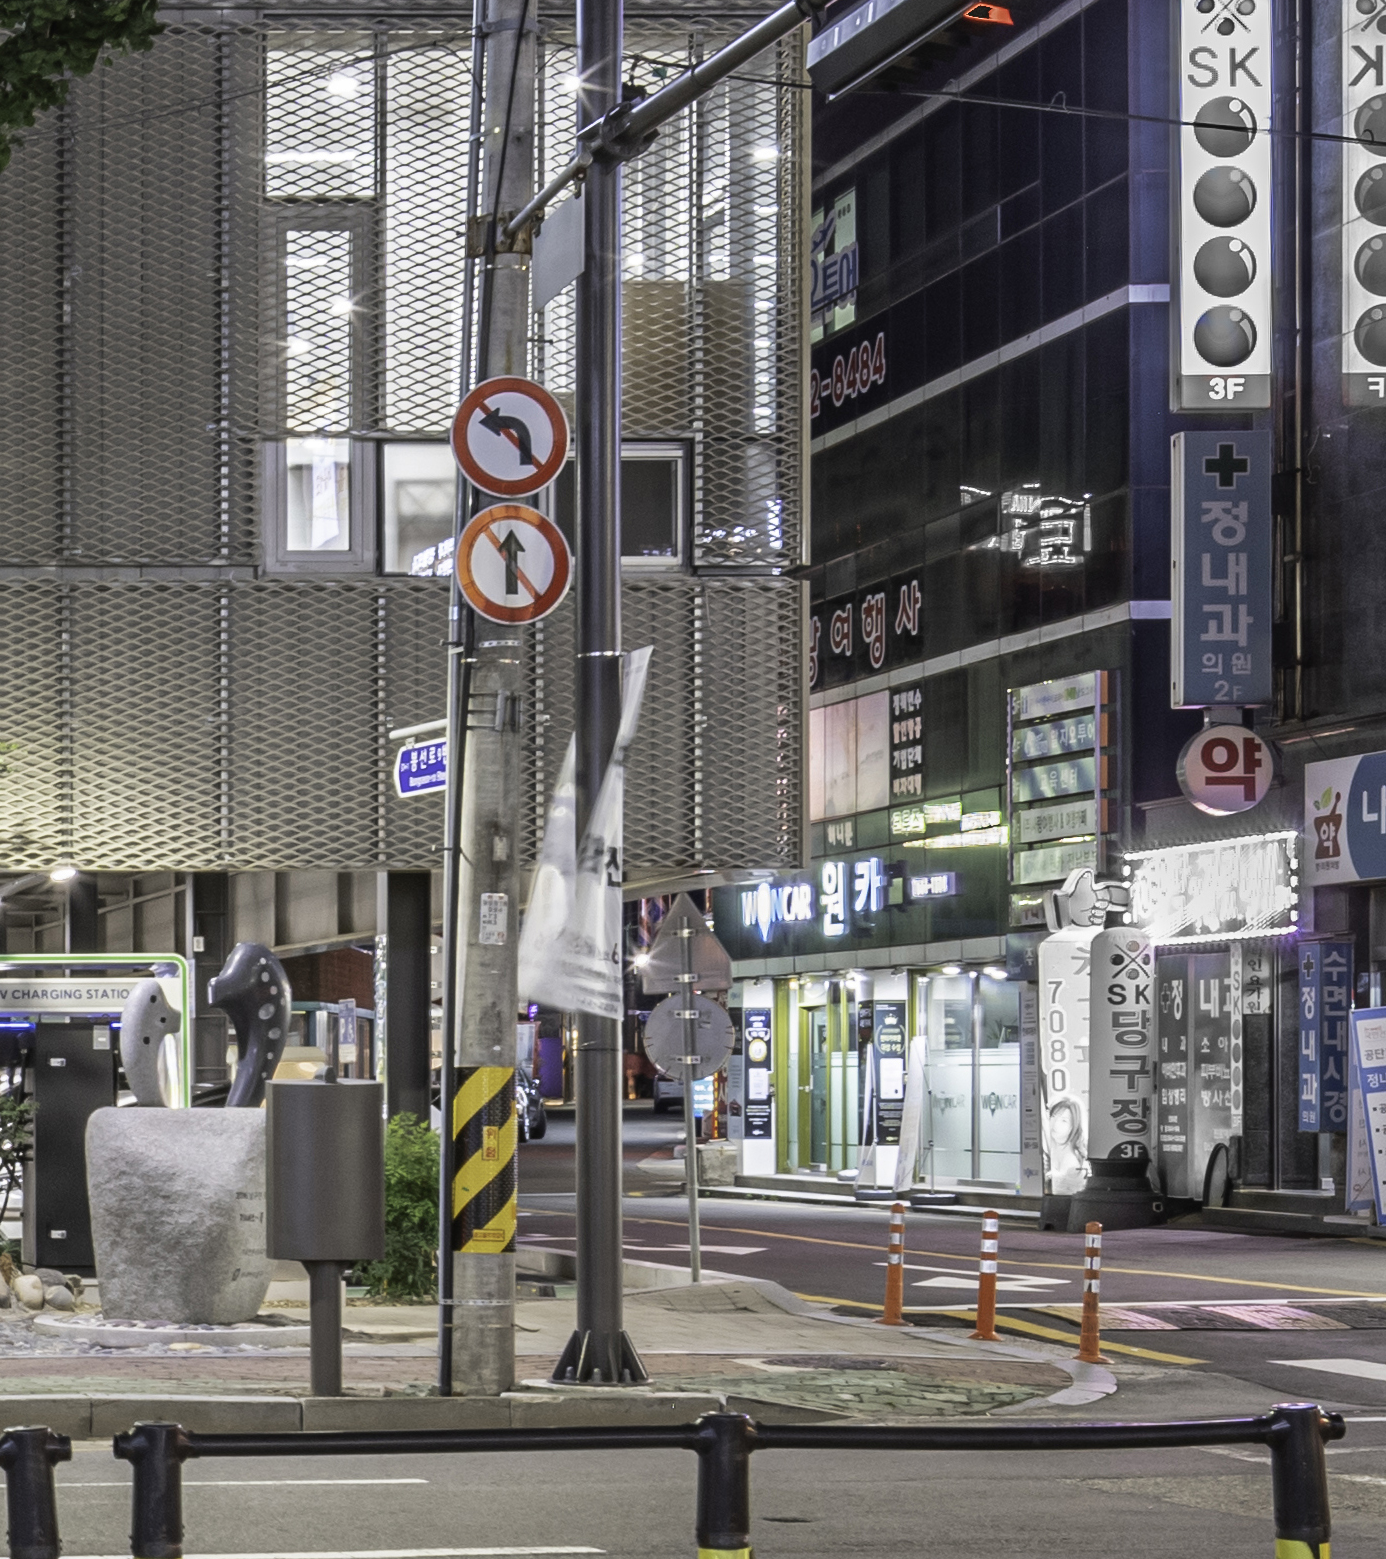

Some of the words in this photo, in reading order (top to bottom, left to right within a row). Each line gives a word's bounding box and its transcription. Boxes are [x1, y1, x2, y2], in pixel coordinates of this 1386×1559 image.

[1187, 45, 1263, 89] SK
[1208, 376, 1246, 400] 3F
[1199, 500, 1254, 648] 정내과
[1201, 652, 1253, 676] 의원
[1213, 681, 1243, 702] 2F
[1200, 736, 1263, 802] 약
[1319, 821, 1336, 857] 약
[821, 857, 884, 937] 원카
[11, 987, 83, 1000] CHARGING
[86, 987, 129, 1000] STATIO
[1106, 983, 1151, 1006] SK
[1047, 980, 1067, 1093] 7080
[1301, 986, 1318, 1105] 정내과
[1322, 950, 1348, 1124] 수면내시경
[1109, 1009, 1151, 1136] 당구장
[1120, 1144, 1145, 1159] 3F
